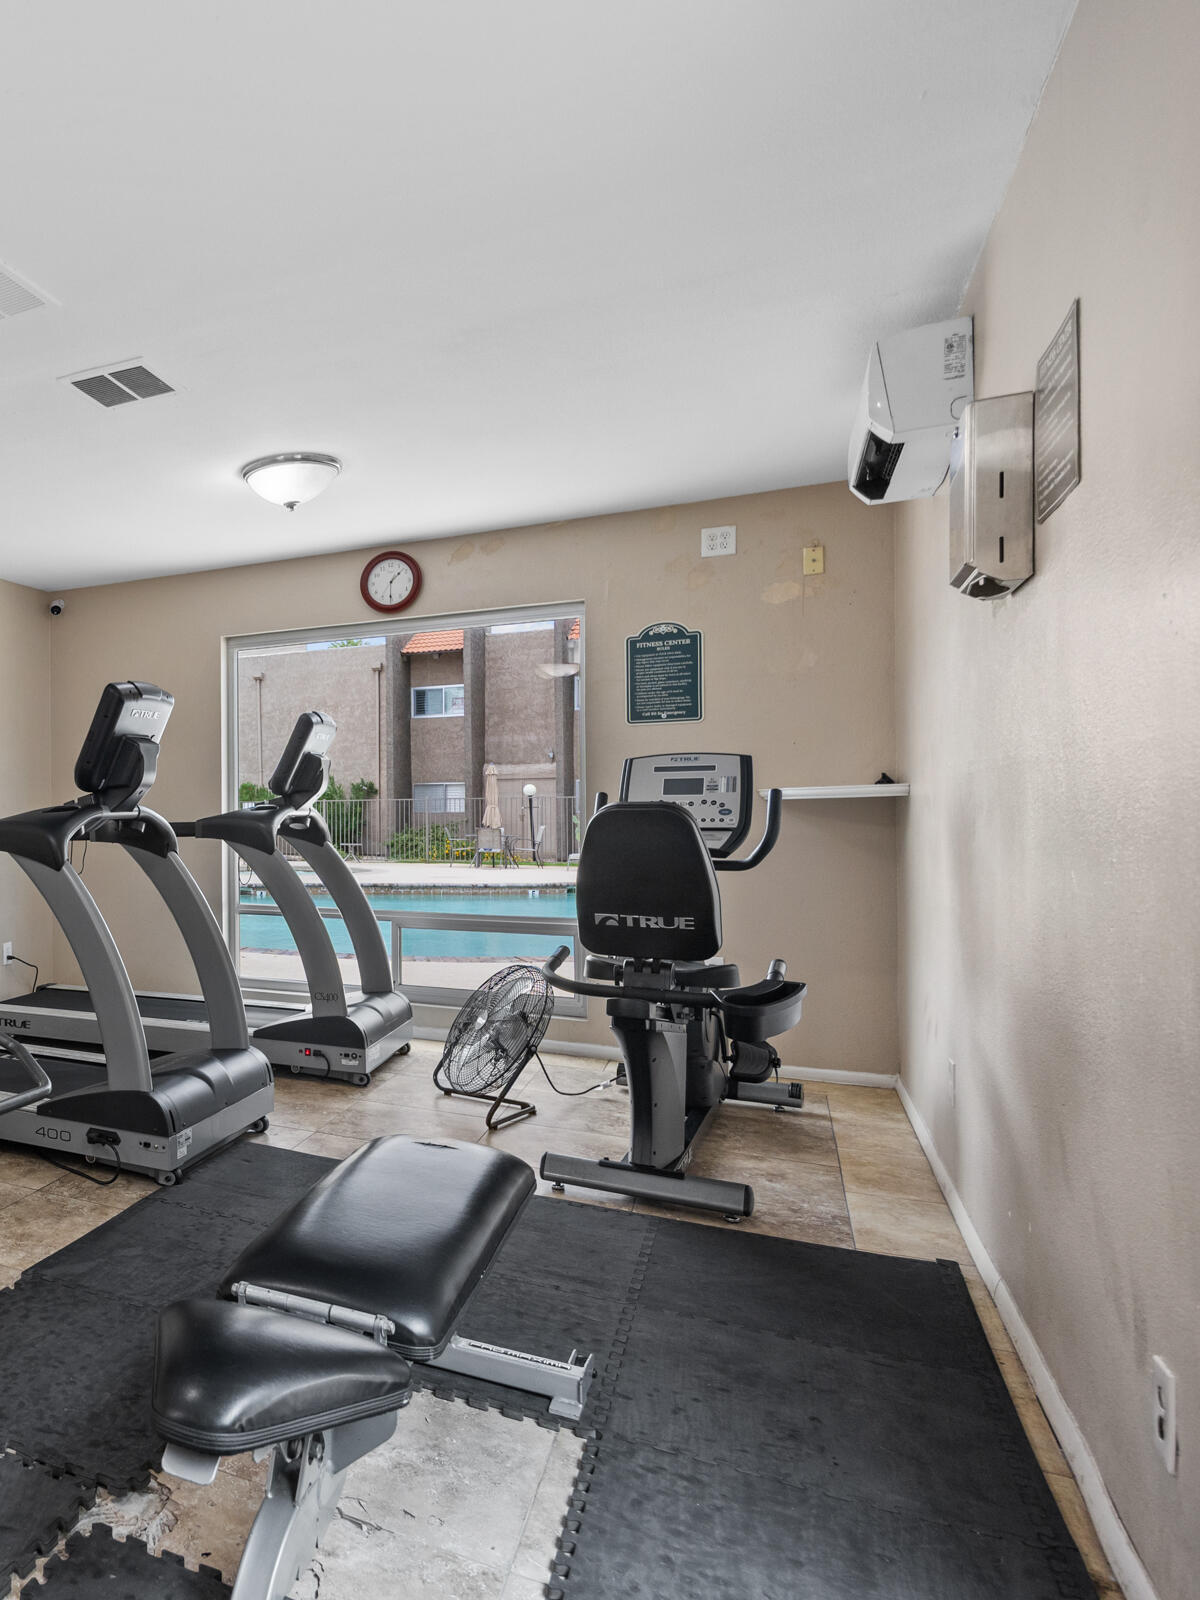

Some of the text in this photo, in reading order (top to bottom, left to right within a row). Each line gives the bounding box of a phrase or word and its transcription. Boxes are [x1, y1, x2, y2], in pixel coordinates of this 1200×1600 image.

[664, 638, 691, 646] CENTER
[140, 710, 161, 719] TRUE
[620, 914, 695, 929] TRUE
[35, 1127, 72, 1142] 400
